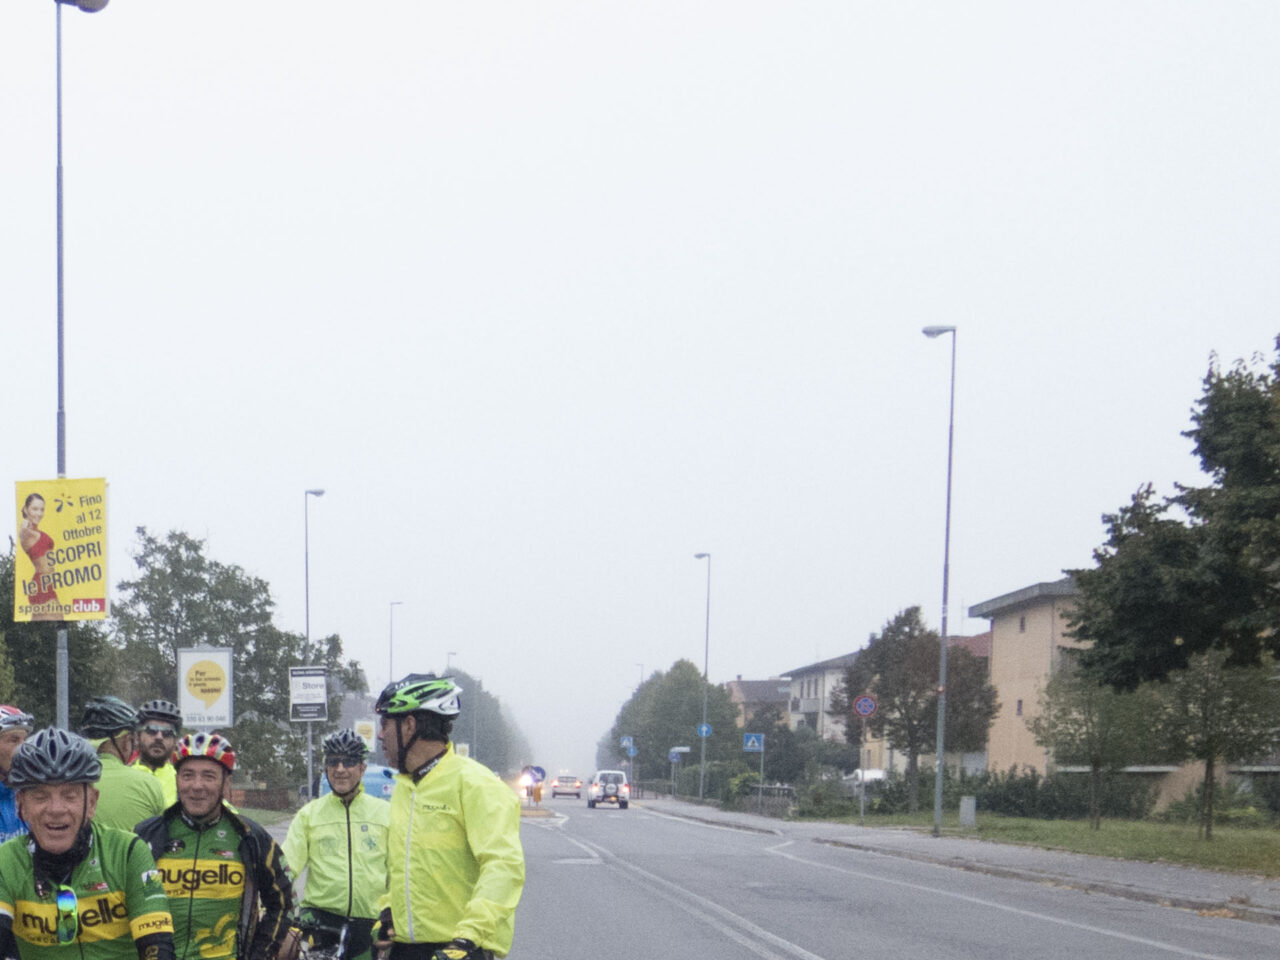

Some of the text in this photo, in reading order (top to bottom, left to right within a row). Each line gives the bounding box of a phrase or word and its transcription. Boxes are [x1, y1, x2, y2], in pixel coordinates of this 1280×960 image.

[79, 495, 102, 508] Fino
[76, 509, 102, 524] al 12
[63, 525, 102, 541] Ottobre
[46, 541, 102, 567] SCOPRI
[22, 563, 102, 596] le PROMO
[18, 600, 101, 616] sporting club
[22, 898, 128, 936] muello
